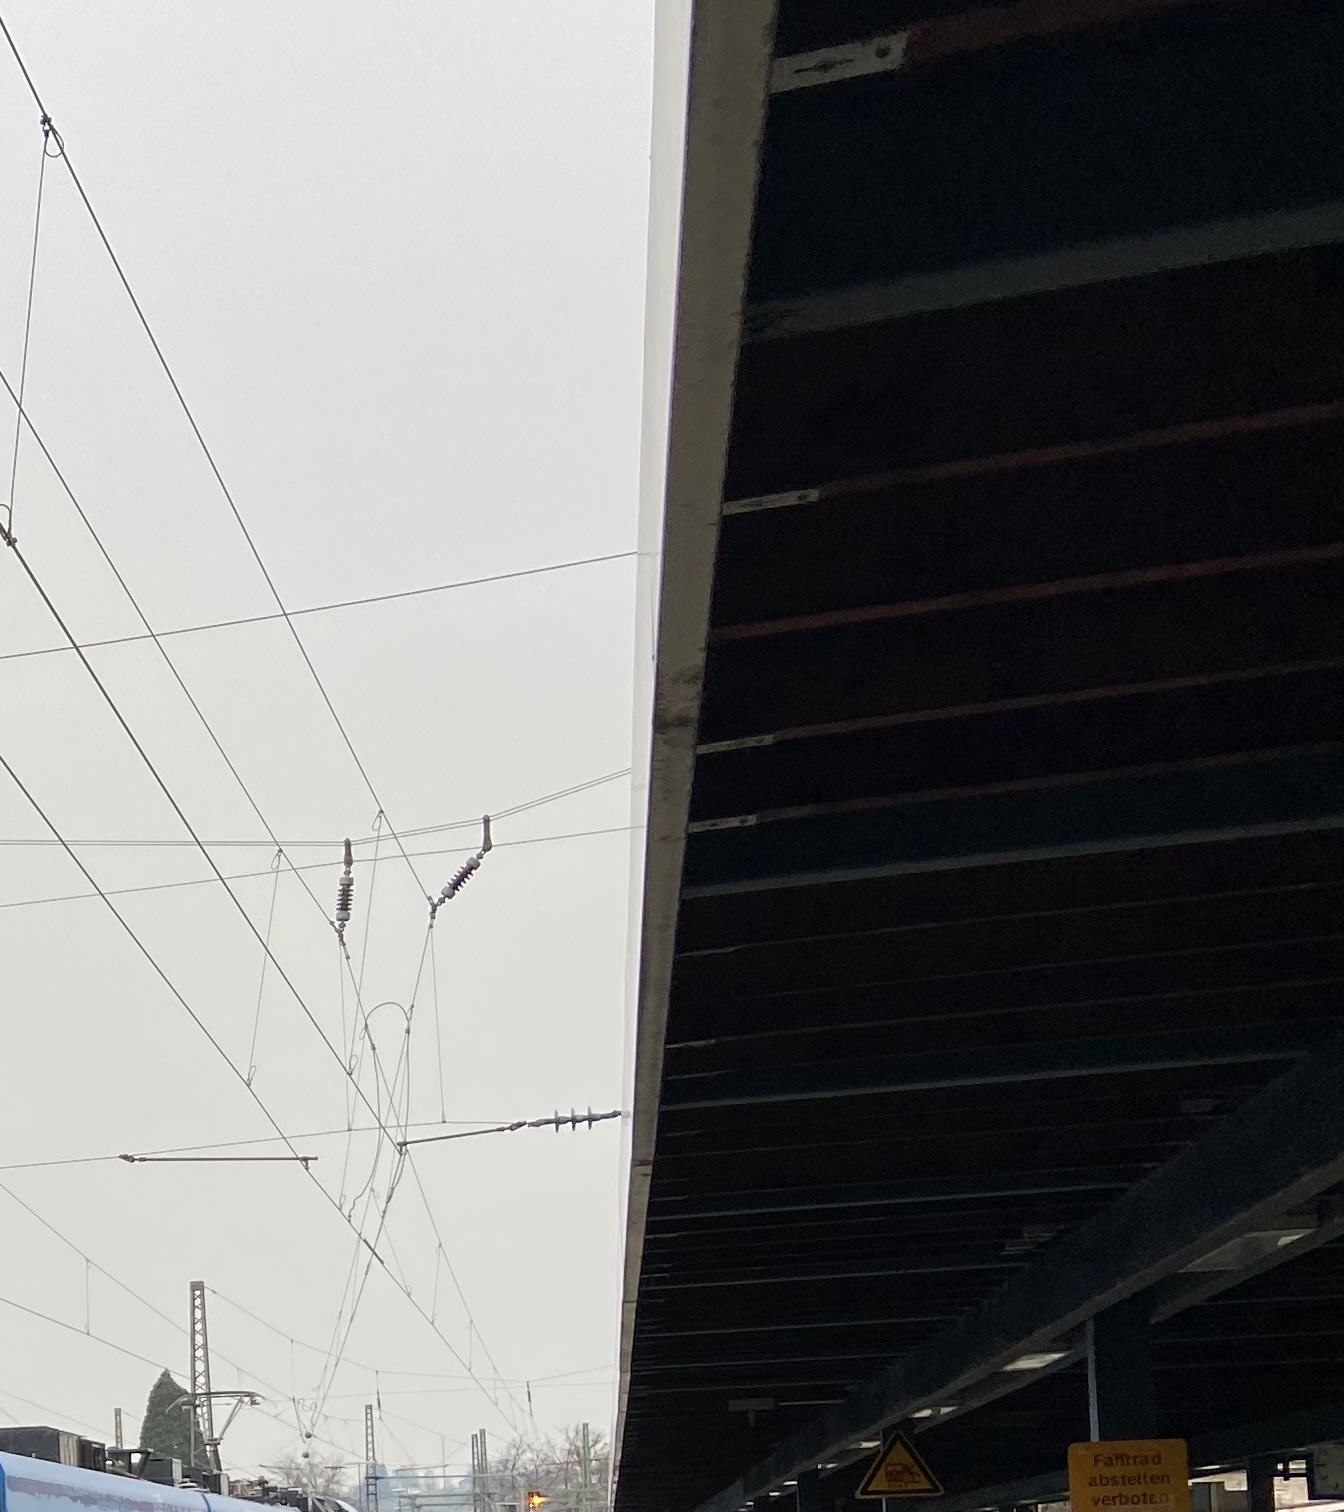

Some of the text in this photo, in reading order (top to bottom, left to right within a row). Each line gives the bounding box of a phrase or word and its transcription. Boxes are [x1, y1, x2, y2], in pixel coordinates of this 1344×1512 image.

[1093, 1452, 1163, 1468] Fahrrad
[1088, 1472, 1171, 1488] abstellen
[1091, 1491, 1170, 1507] verboten
